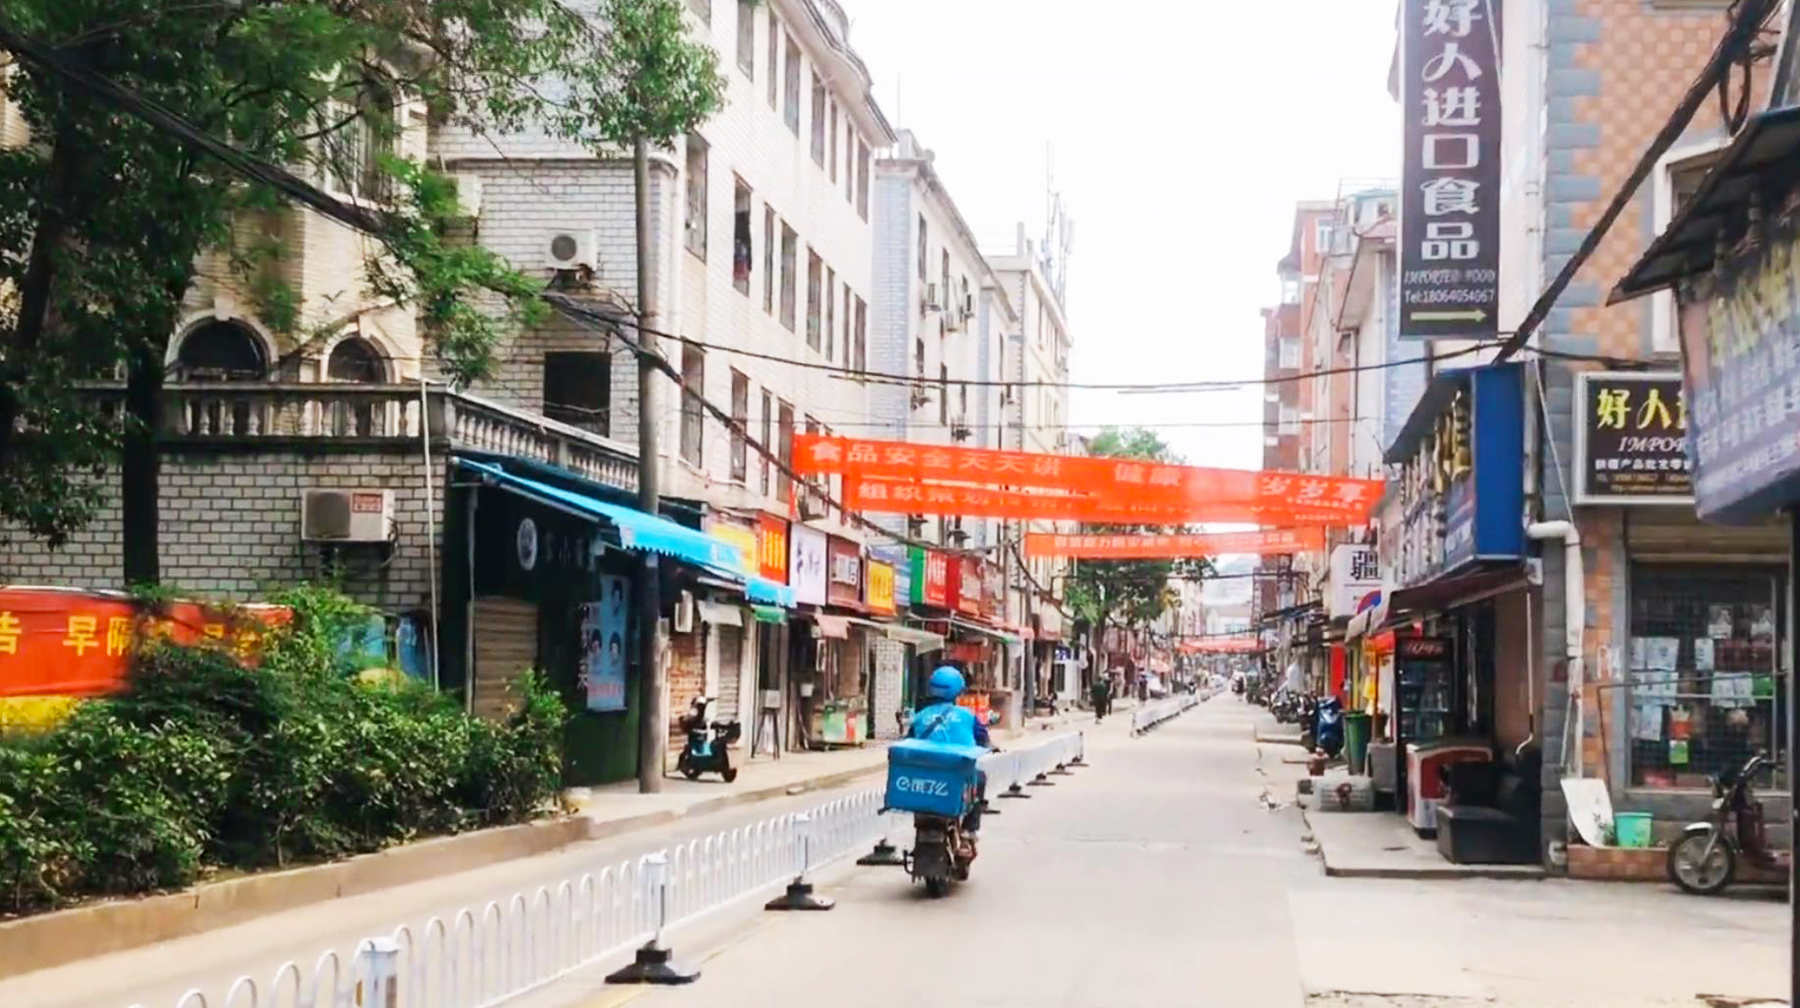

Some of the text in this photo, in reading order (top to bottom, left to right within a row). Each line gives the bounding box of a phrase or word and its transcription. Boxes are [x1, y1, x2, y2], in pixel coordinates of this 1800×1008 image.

[1419, 0, 1483, 261] 好人进口食品
[811, 440, 1063, 478] 食品安全天天讲
